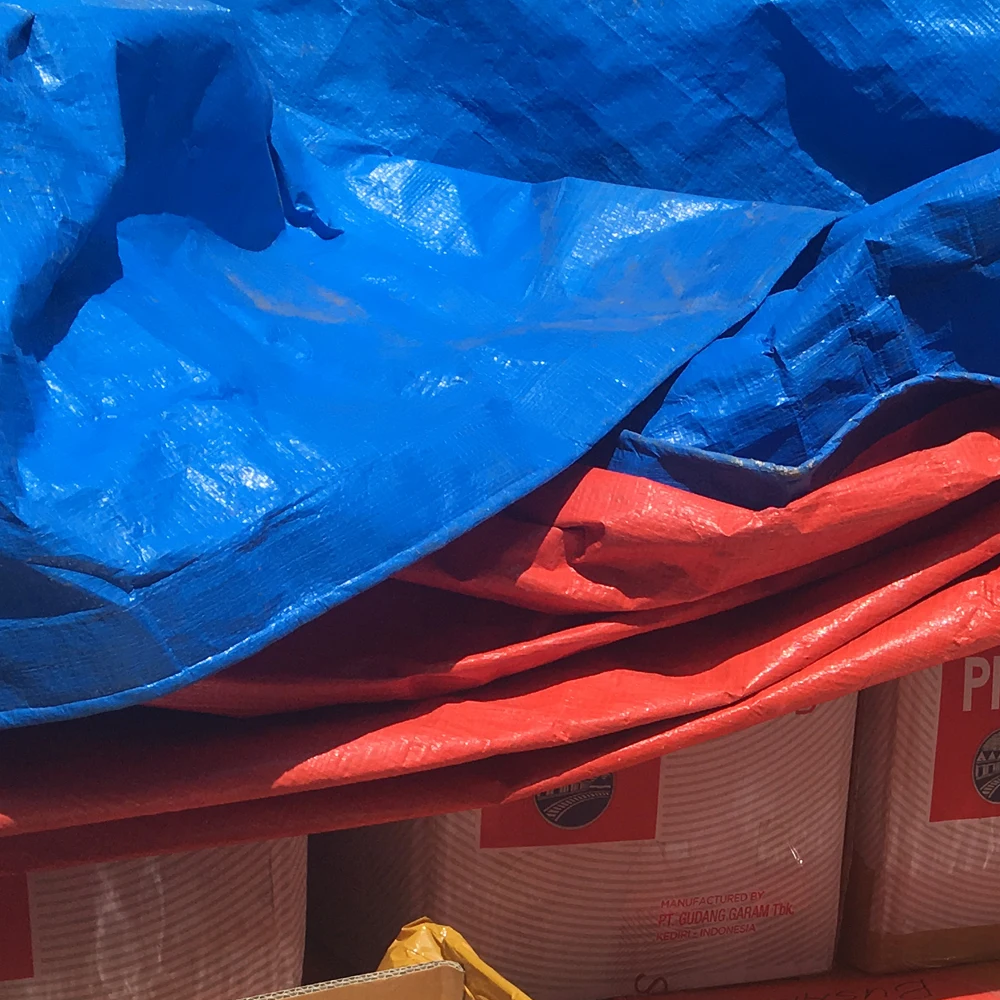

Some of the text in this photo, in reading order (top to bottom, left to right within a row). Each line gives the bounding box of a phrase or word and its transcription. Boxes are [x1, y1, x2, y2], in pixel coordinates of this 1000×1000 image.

[661, 891, 766, 909] MANUFACTURED BY
[679, 907, 726, 926] GUDANG
[728, 903, 770, 921] GARAM
[656, 930, 691, 943] KEDIRI
[700, 923, 757, 937] INDONESIA
